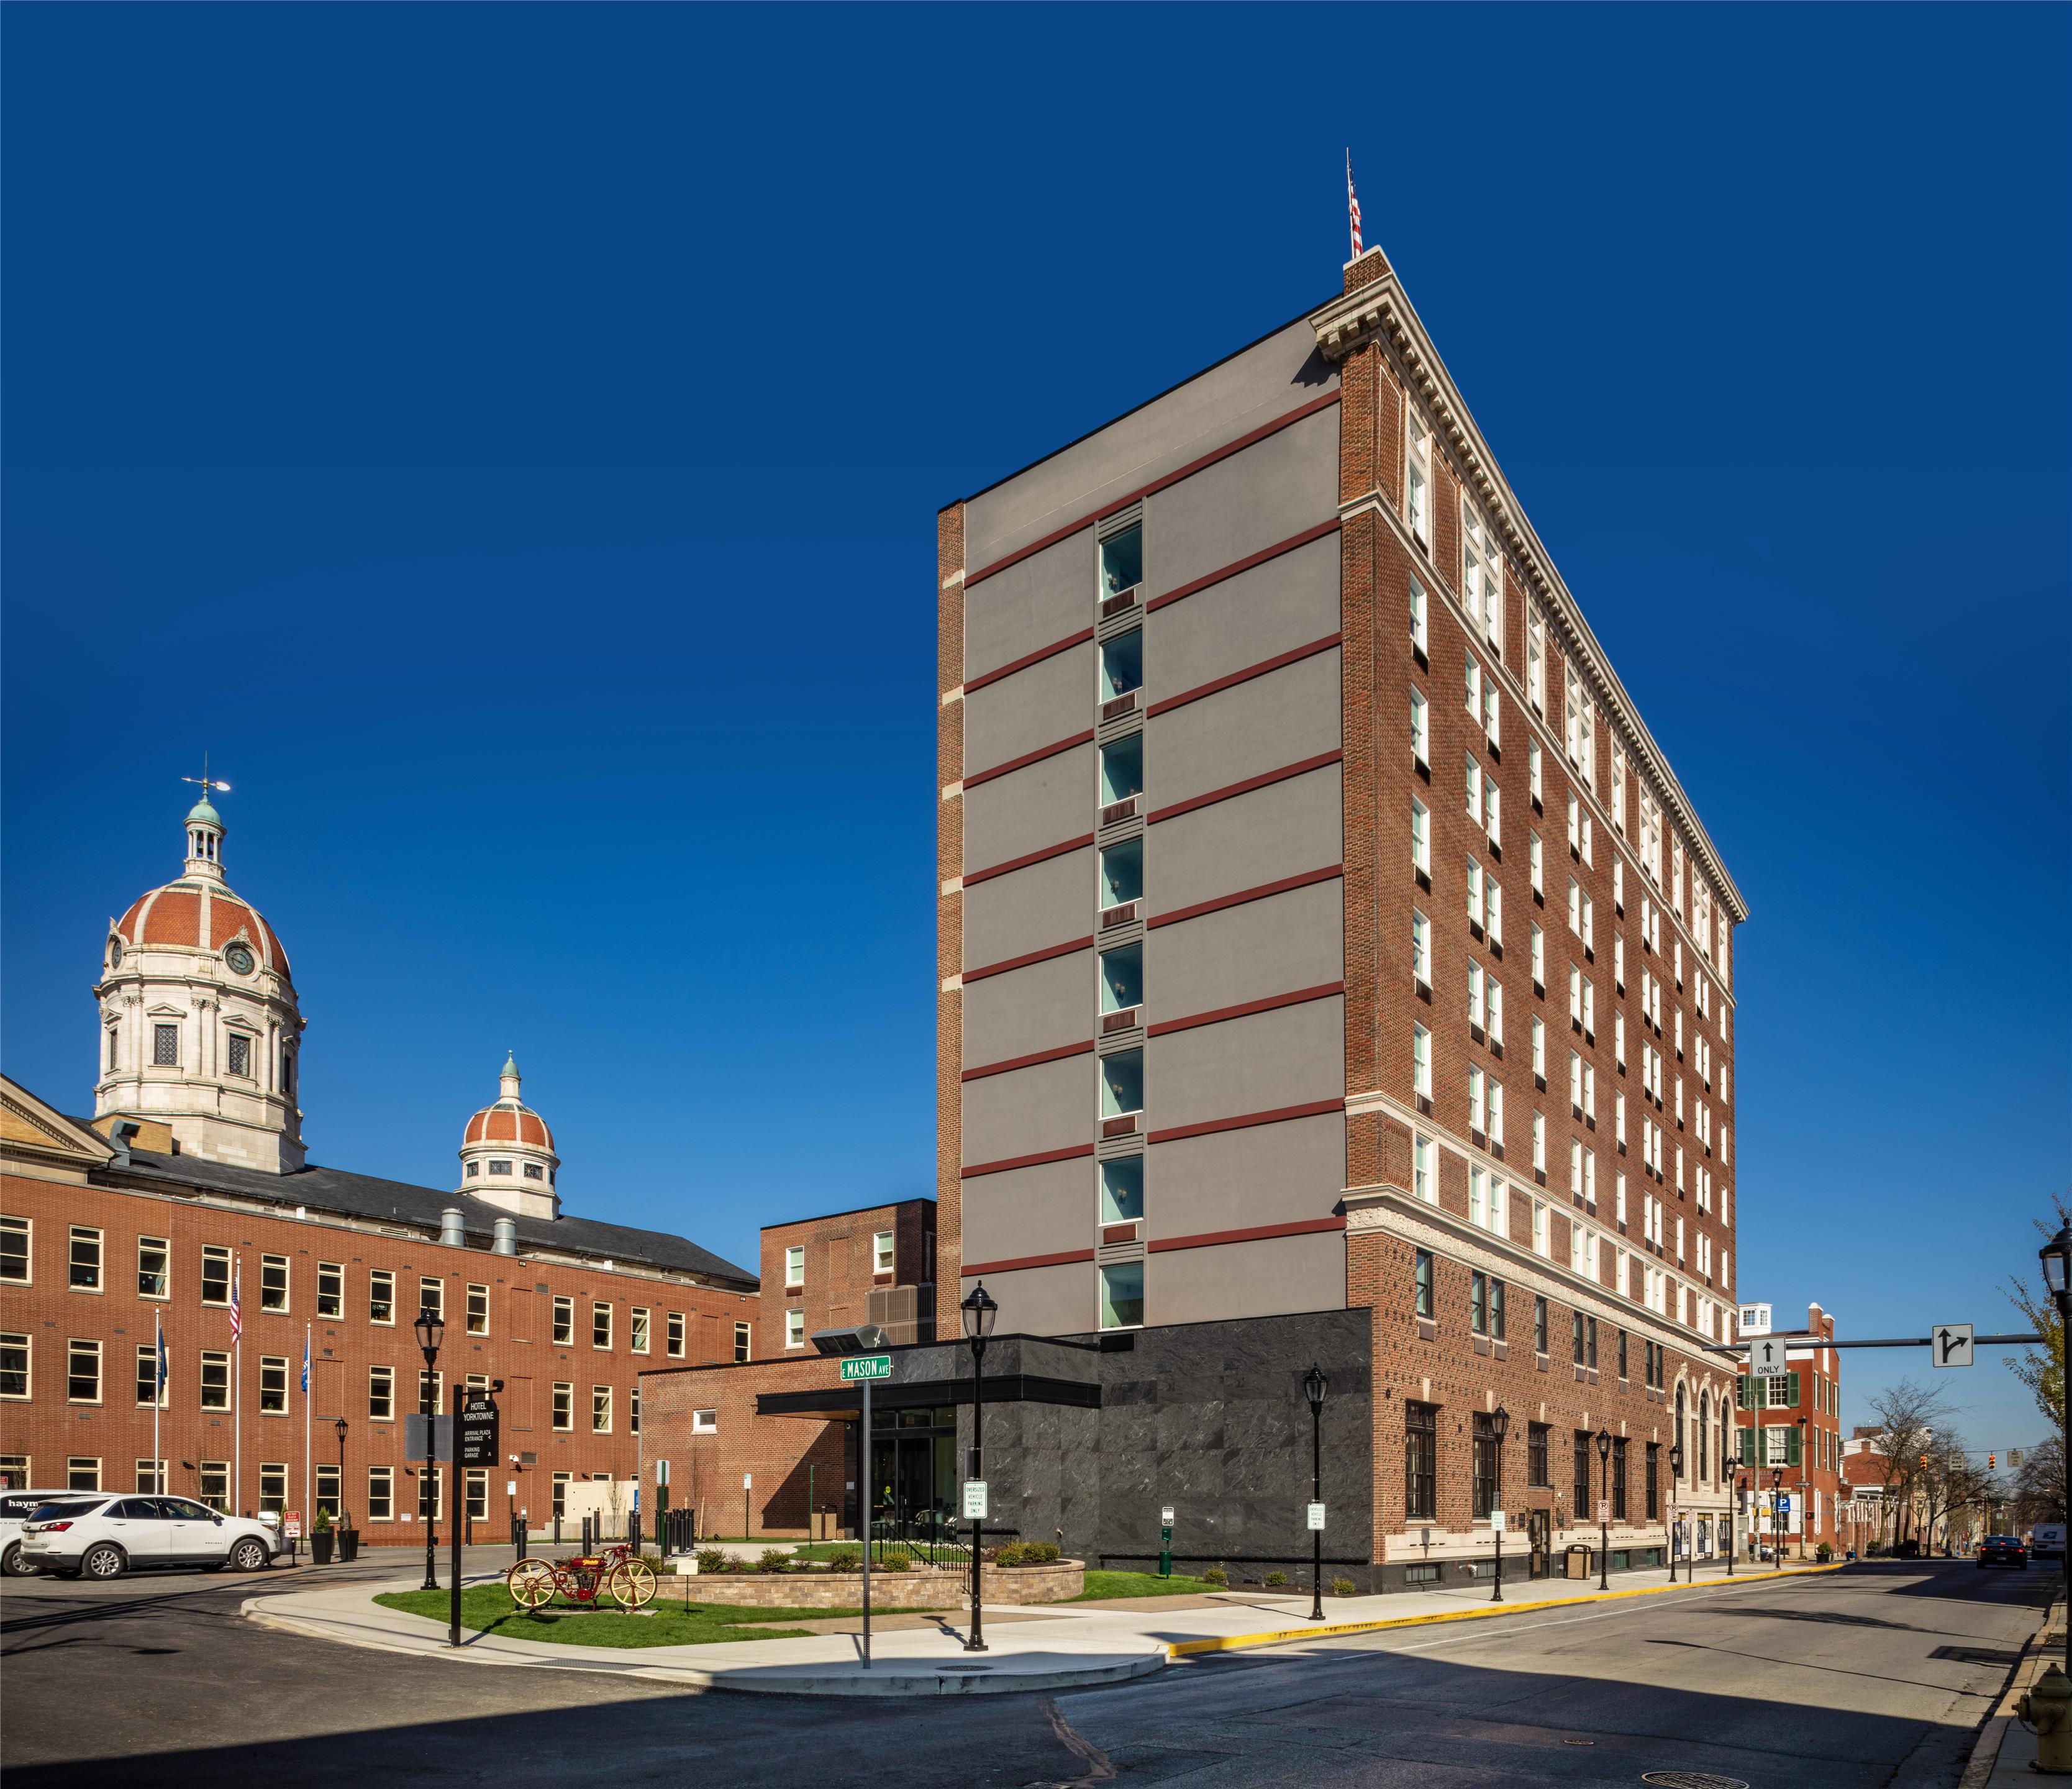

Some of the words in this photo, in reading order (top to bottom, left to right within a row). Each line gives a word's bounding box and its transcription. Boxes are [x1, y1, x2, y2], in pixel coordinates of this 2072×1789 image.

[842, 1368, 845, 1378] E
[847, 1360, 877, 1377] MASON
[879, 1365, 889, 1375] AVE
[1758, 1365, 1779, 1374] ONLY
[471, 1402, 486, 1410] HOTEL
[463, 1411, 494, 1421] YORKTOWNE
